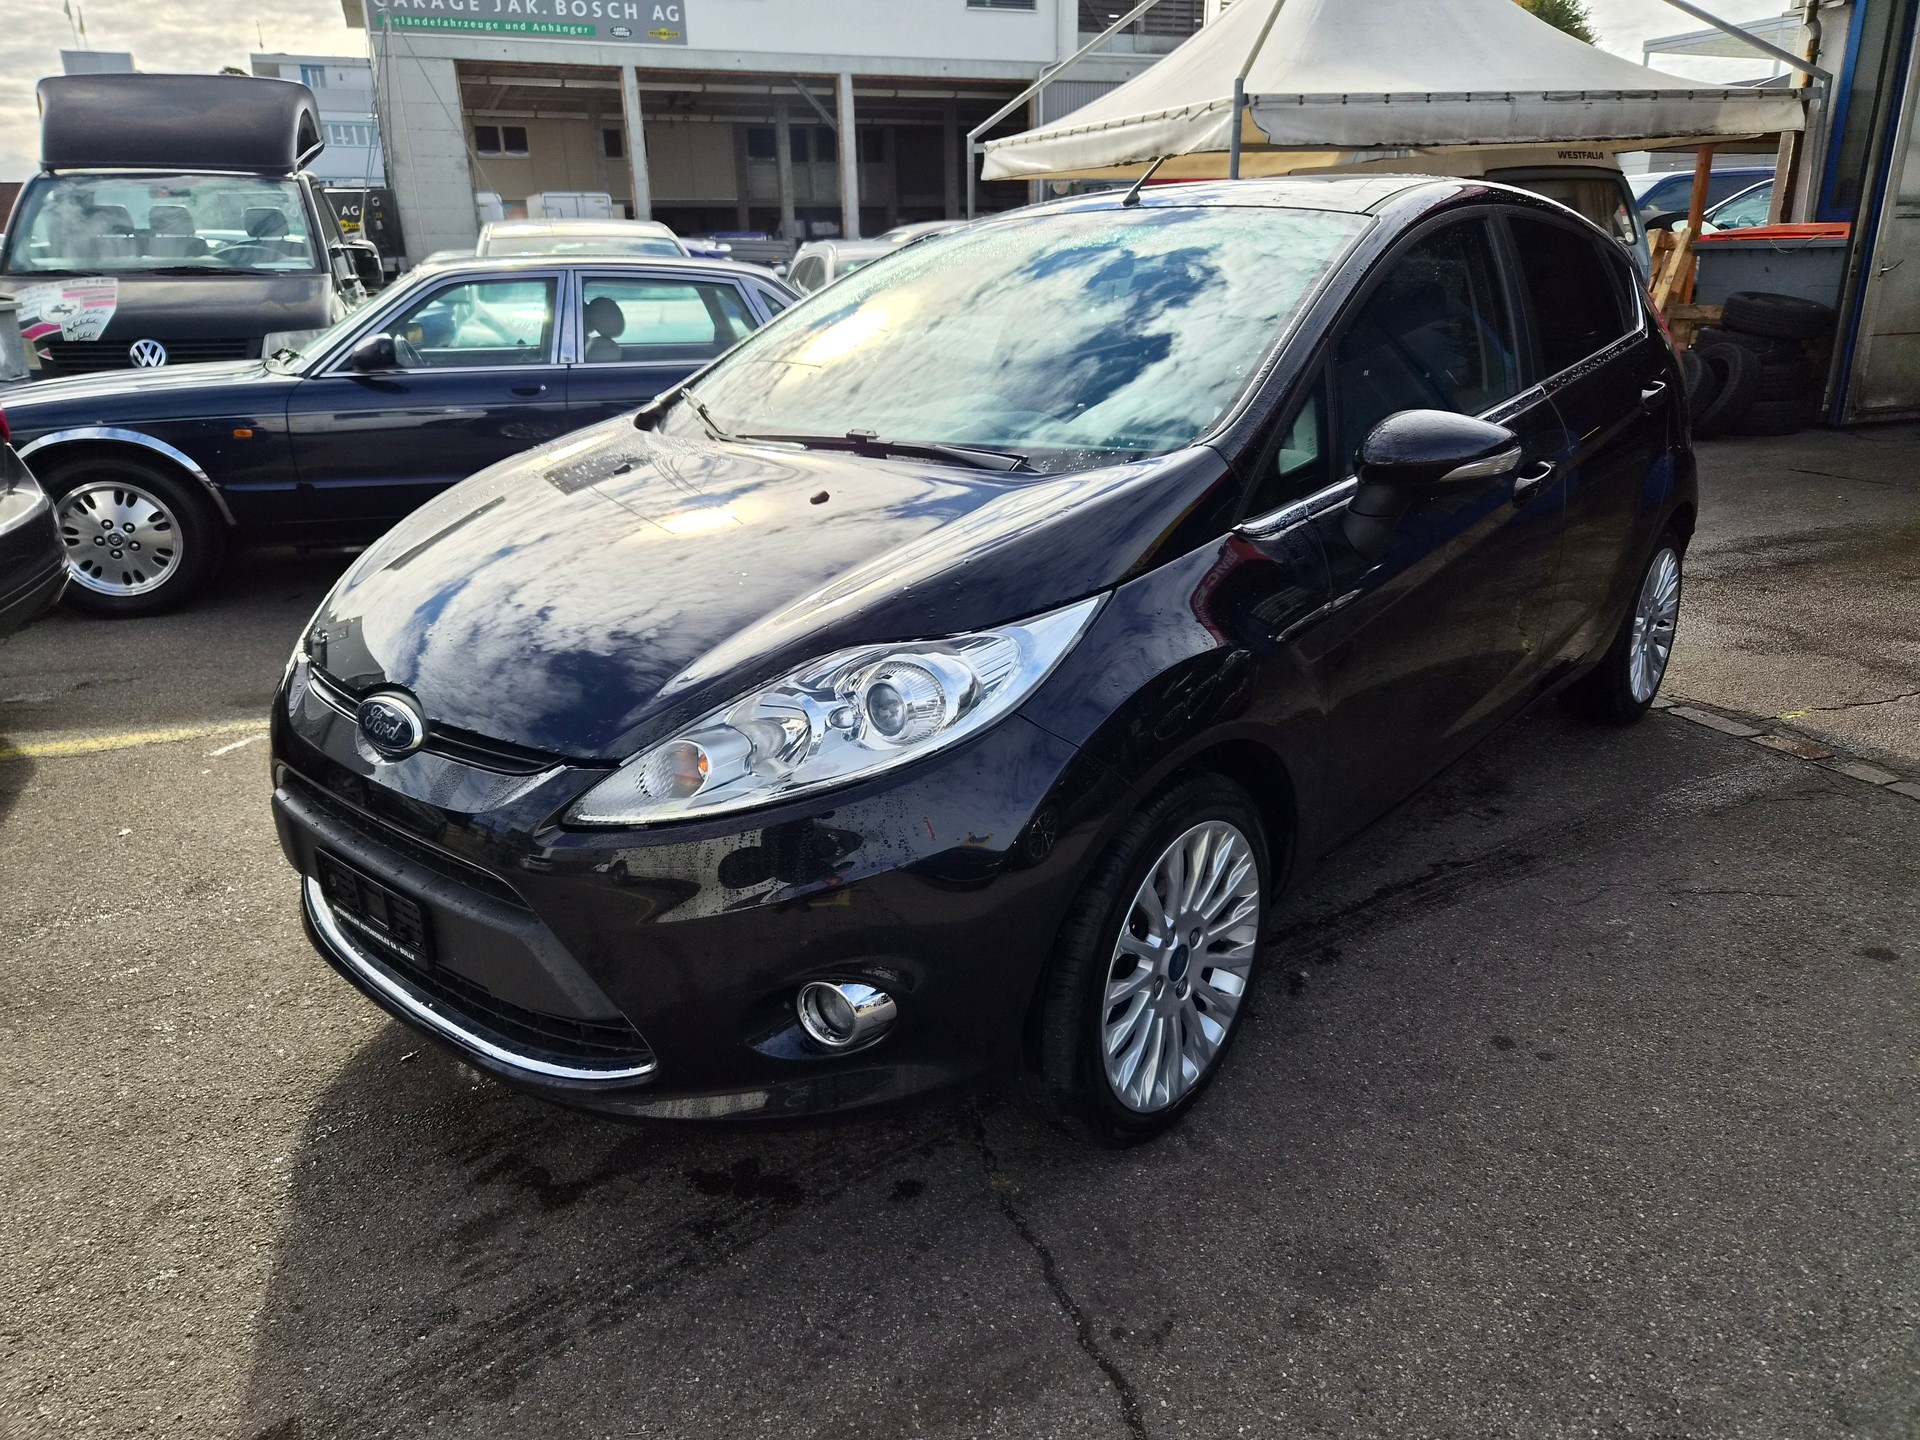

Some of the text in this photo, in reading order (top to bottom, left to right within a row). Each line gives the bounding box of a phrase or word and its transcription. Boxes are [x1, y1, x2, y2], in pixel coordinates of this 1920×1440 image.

[494, 0, 547, 14] JAK.
[555, 0, 637, 19] BOSCH
[652, 5, 679, 21] AG
[386, 16, 588, 35] eländefahrzeuge und Anhänger
[1558, 151, 1604, 159] WESTFALIA
[342, 206, 360, 215] AG
[365, 704, 401, 741] Ford
